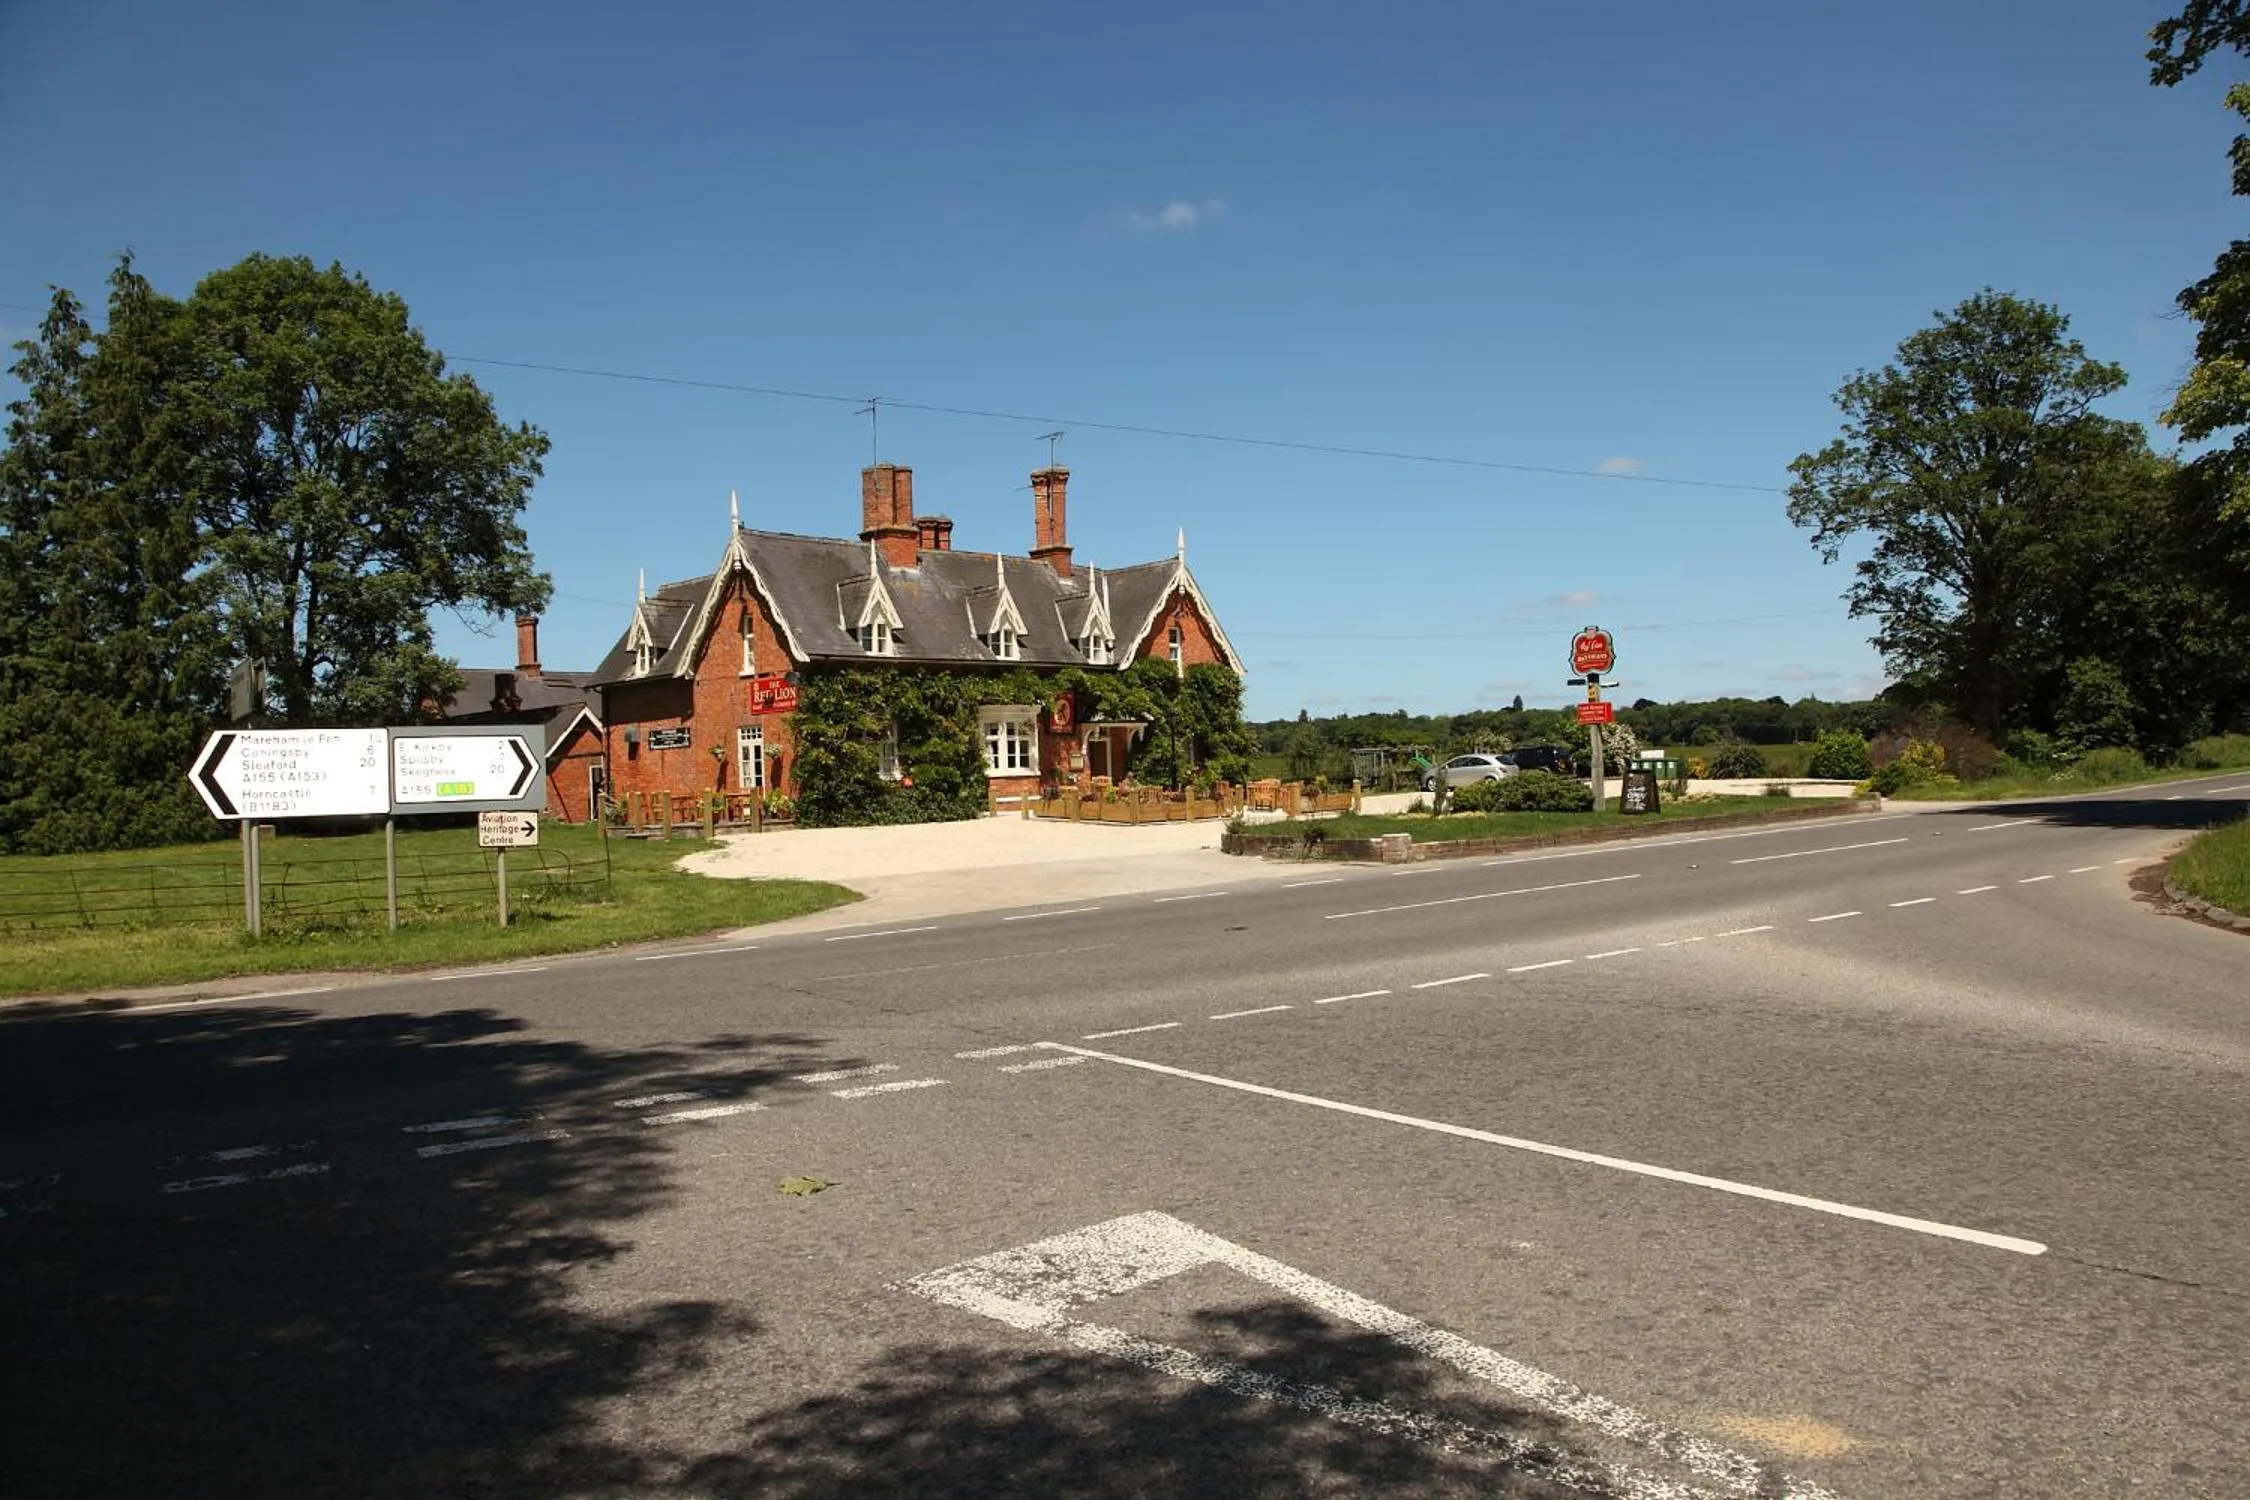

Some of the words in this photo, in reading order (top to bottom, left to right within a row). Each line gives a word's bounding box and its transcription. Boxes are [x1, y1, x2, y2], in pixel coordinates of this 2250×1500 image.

[774, 687, 796, 701] LION
[241, 734, 300, 745] Mareham
[318, 733, 341, 744] Fen
[241, 748, 309, 758] Coningsby
[242, 759, 297, 771] Sleaford
[359, 757, 376, 768] 20
[242, 772, 276, 783] A155
[242, 789, 311, 800] Horncastle
[481, 814, 518, 823] Aviation
[481, 825, 519, 834] Heritage
[482, 835, 514, 845] Centre
